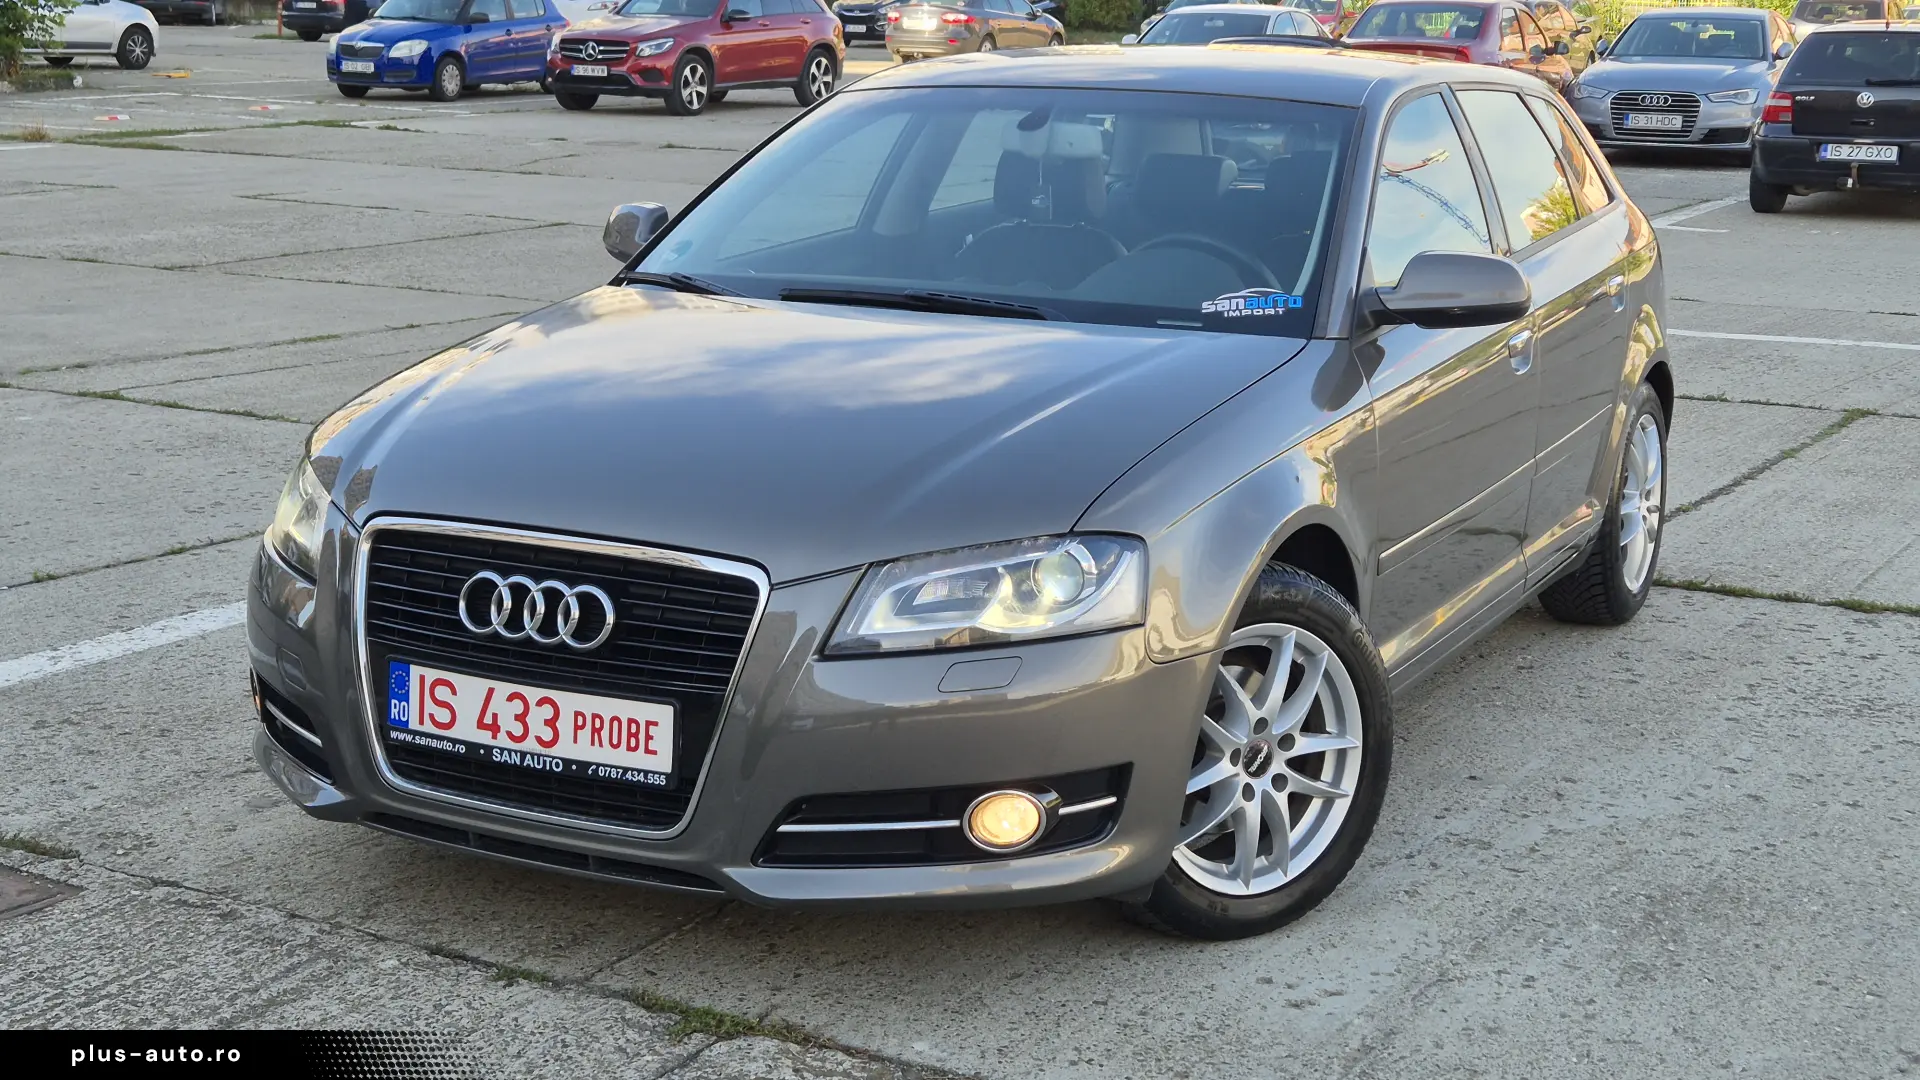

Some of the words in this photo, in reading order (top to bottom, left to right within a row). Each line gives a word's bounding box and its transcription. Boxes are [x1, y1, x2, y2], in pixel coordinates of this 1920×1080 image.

[1631, 115, 1640, 125] IS
[1644, 115, 1653, 125] 31
[1656, 116, 1678, 126] HDC
[1830, 145, 1842, 157] IS
[1847, 146, 1862, 157] 27
[1223, 307, 1286, 317] IMPORT
[390, 698, 409, 722] RO
[418, 673, 458, 731] IS
[476, 686, 561, 749] 433
[573, 709, 659, 756] PROBE
[389, 729, 466, 754] www.sanauto.ro
[492, 748, 521, 768] SAN
[523, 754, 564, 773] AUTO
[598, 765, 667, 787] 0787.434.555
